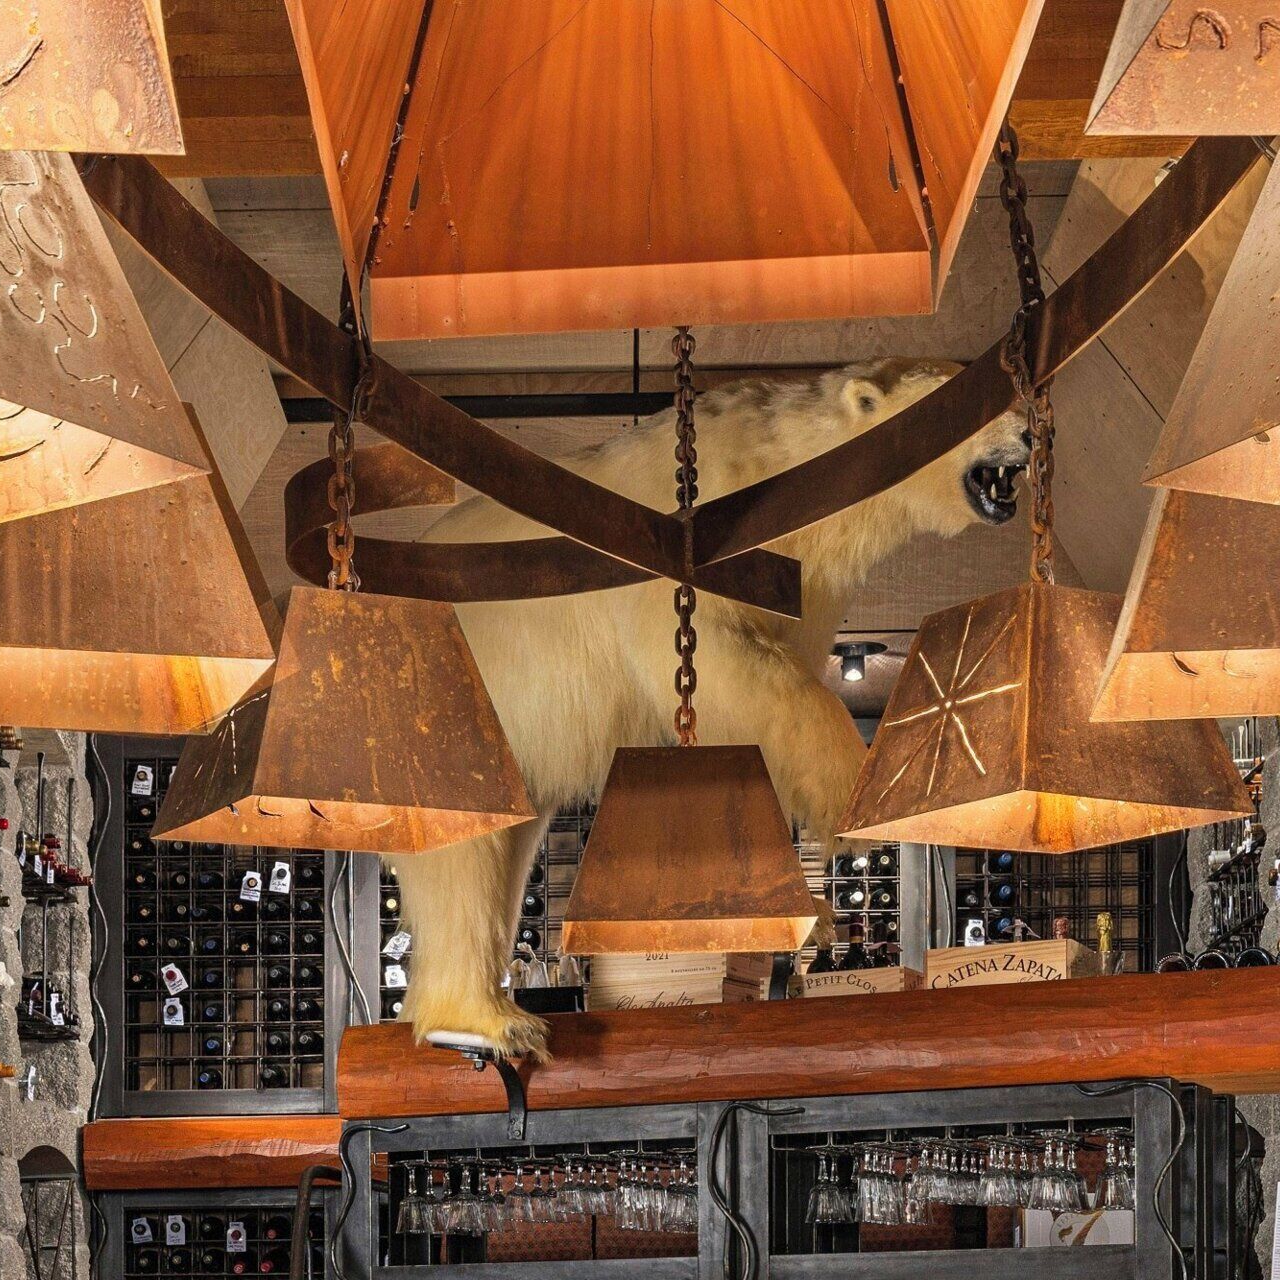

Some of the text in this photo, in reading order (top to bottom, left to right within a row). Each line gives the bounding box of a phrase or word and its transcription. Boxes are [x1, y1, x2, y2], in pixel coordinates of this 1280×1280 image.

[646, 953, 669, 961] 2021
[931, 958, 999, 989] CATENA
[1002, 954, 1063, 980] ZAPATA
[806, 975, 843, 989] PETIT
[846, 974, 878, 993] CLOS
[616, 995, 644, 1011] Clo
